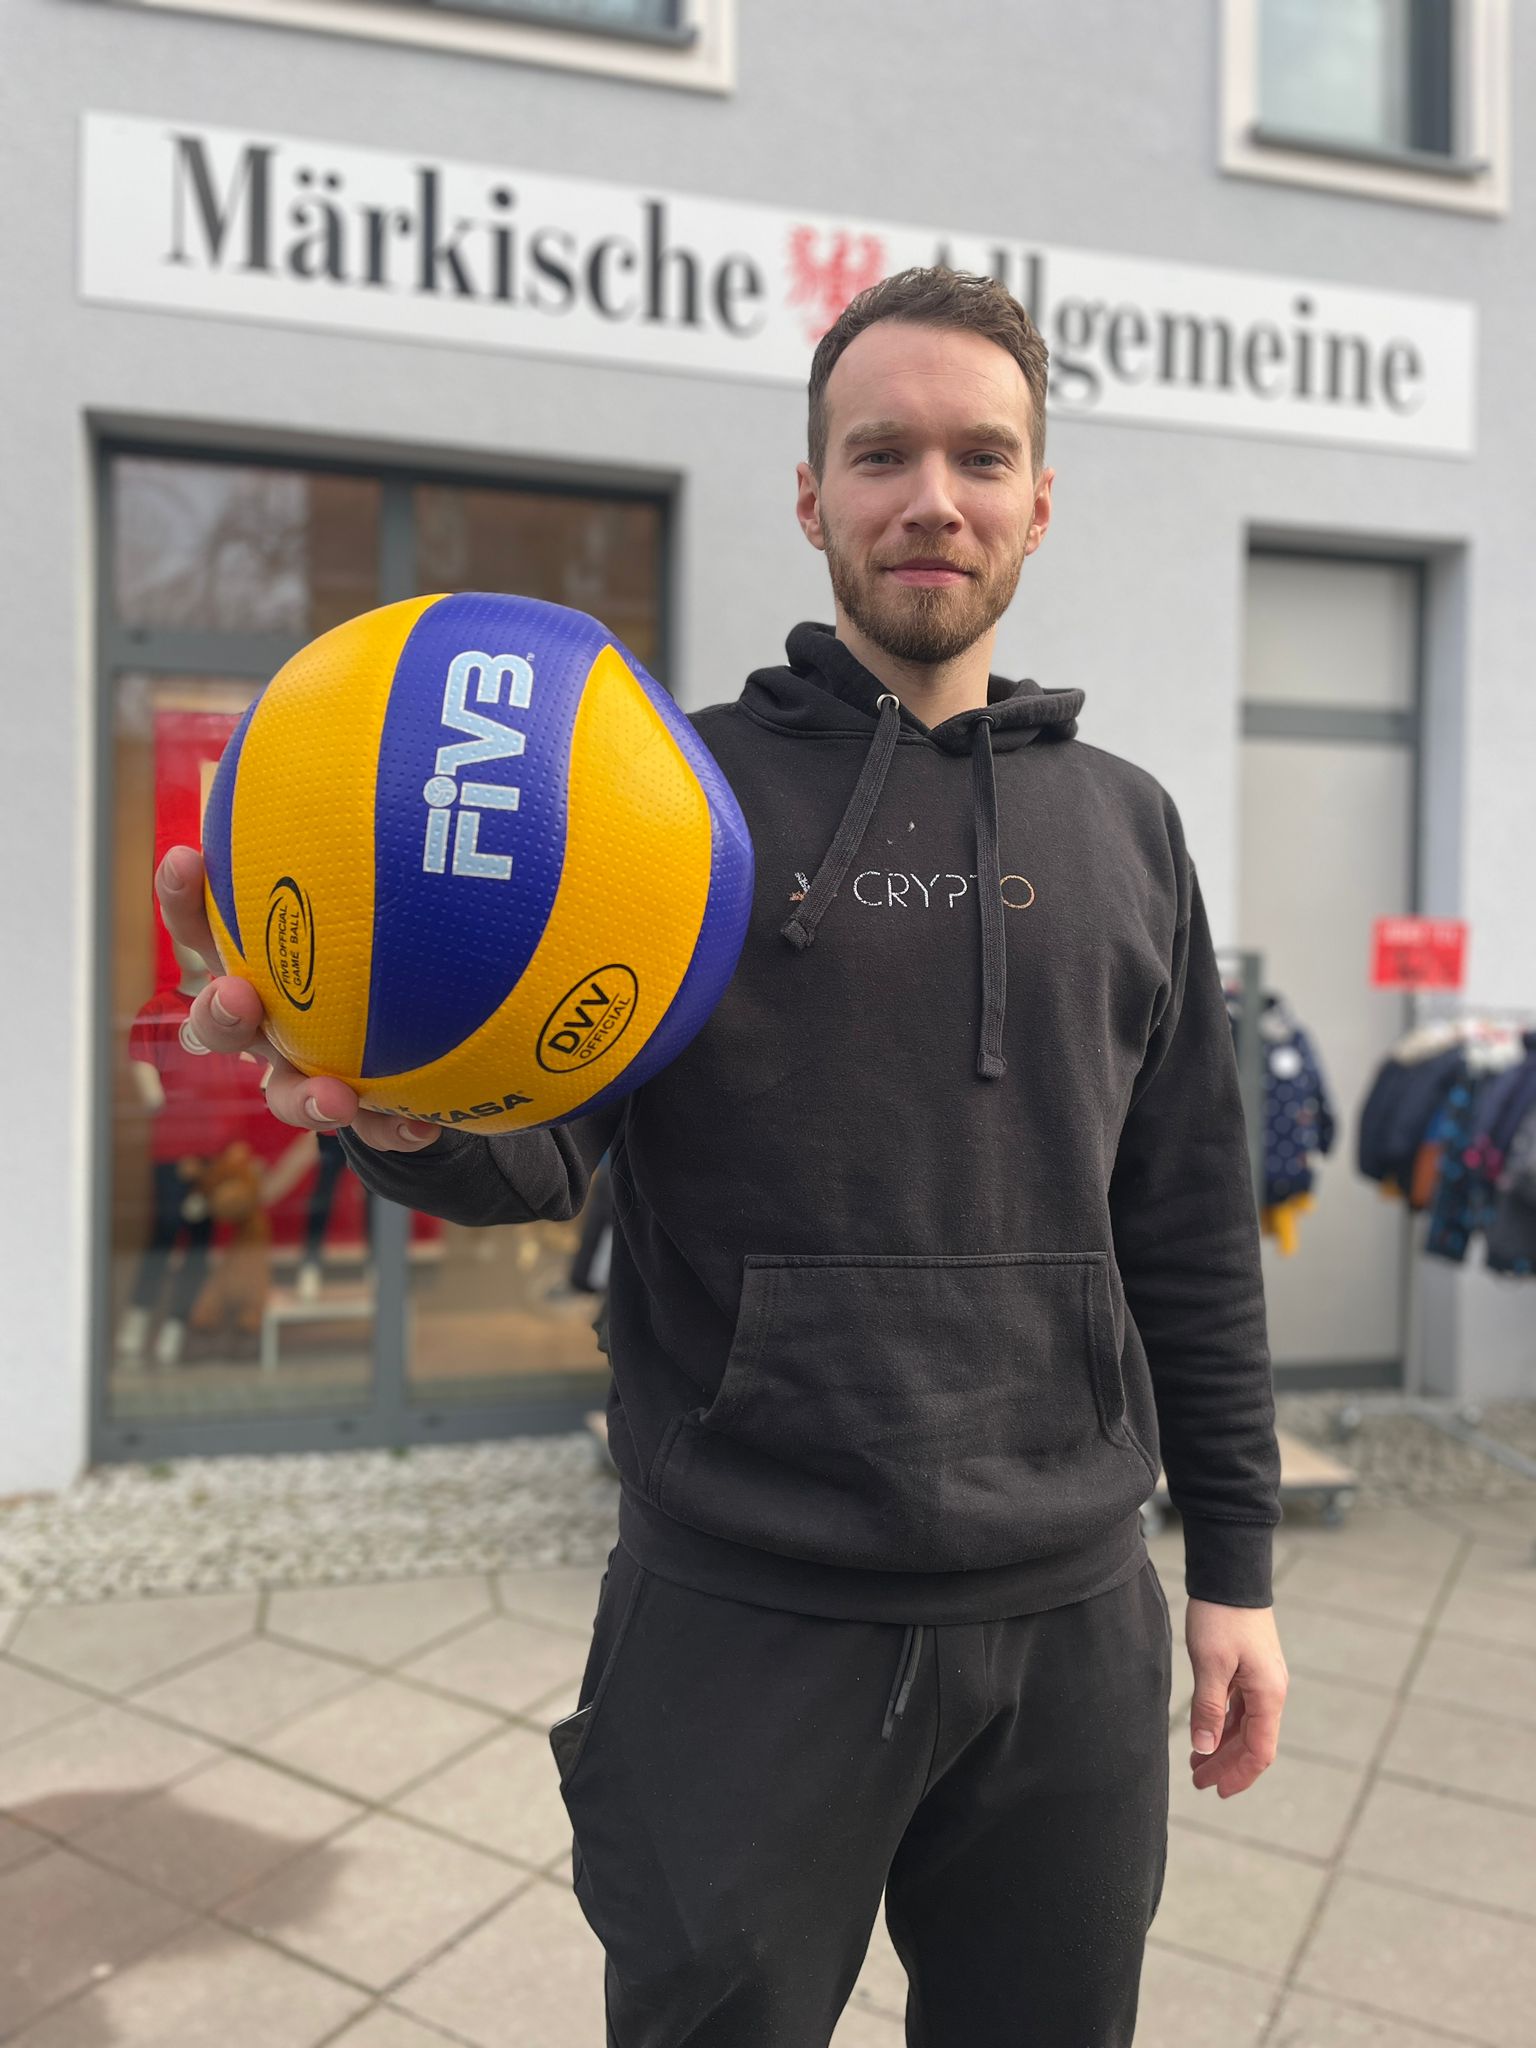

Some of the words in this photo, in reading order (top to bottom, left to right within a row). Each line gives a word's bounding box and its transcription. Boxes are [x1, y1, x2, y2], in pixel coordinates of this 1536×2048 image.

[164, 132, 767, 341] Märkische
[934, 240, 1425, 417] lgemeine
[853, 870, 1035, 909] CRYPO
[278, 905, 289, 957] OFFICIAL
[290, 911, 300, 945] BALL
[280, 959, 291, 985] FIVB
[290, 951, 302, 986] GAME
[547, 982, 610, 1054] DVV
[579, 998, 631, 1060] OFFICIAL
[370, 1092, 535, 1124] KASA
